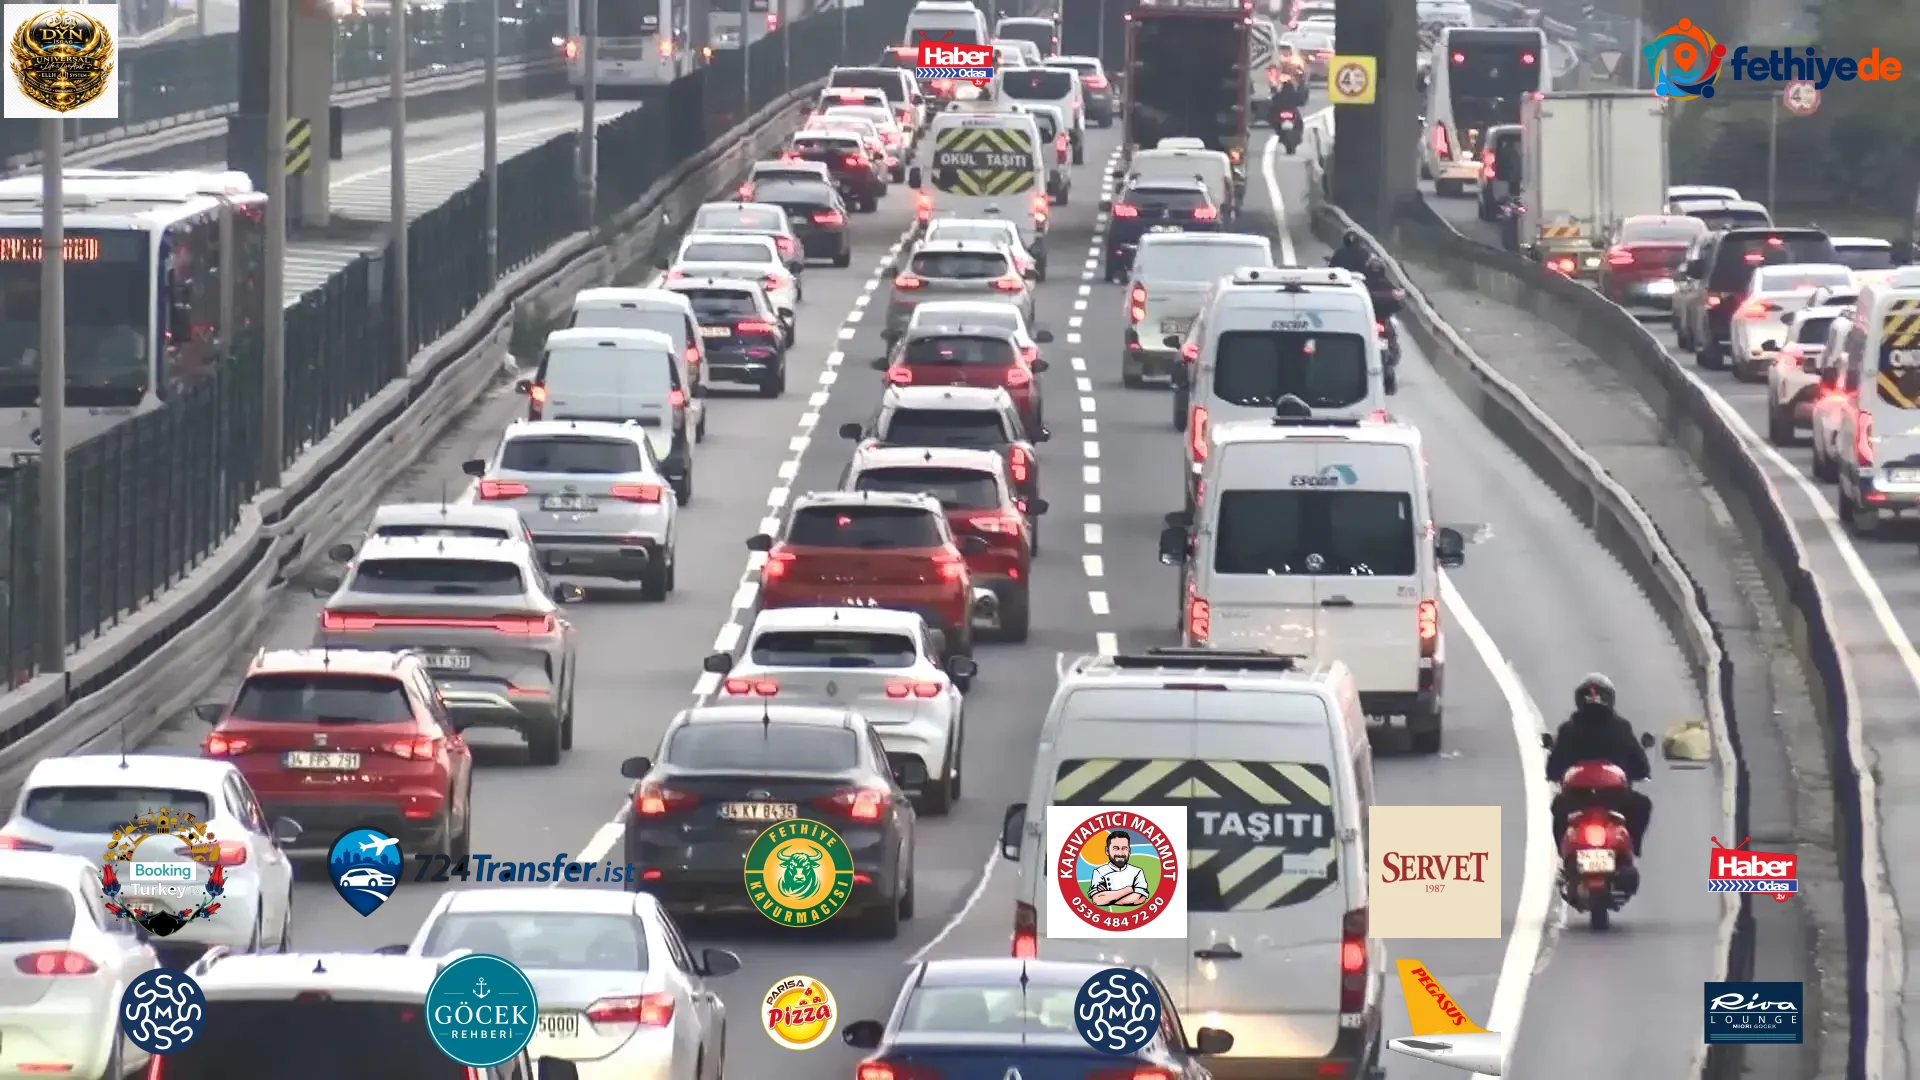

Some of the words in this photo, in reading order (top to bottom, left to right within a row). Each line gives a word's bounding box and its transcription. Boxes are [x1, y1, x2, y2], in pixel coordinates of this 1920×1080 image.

[941, 153, 976, 165] OKUL
[742, 804, 758, 817] KY
[1196, 811, 1323, 842] TAŞITI
